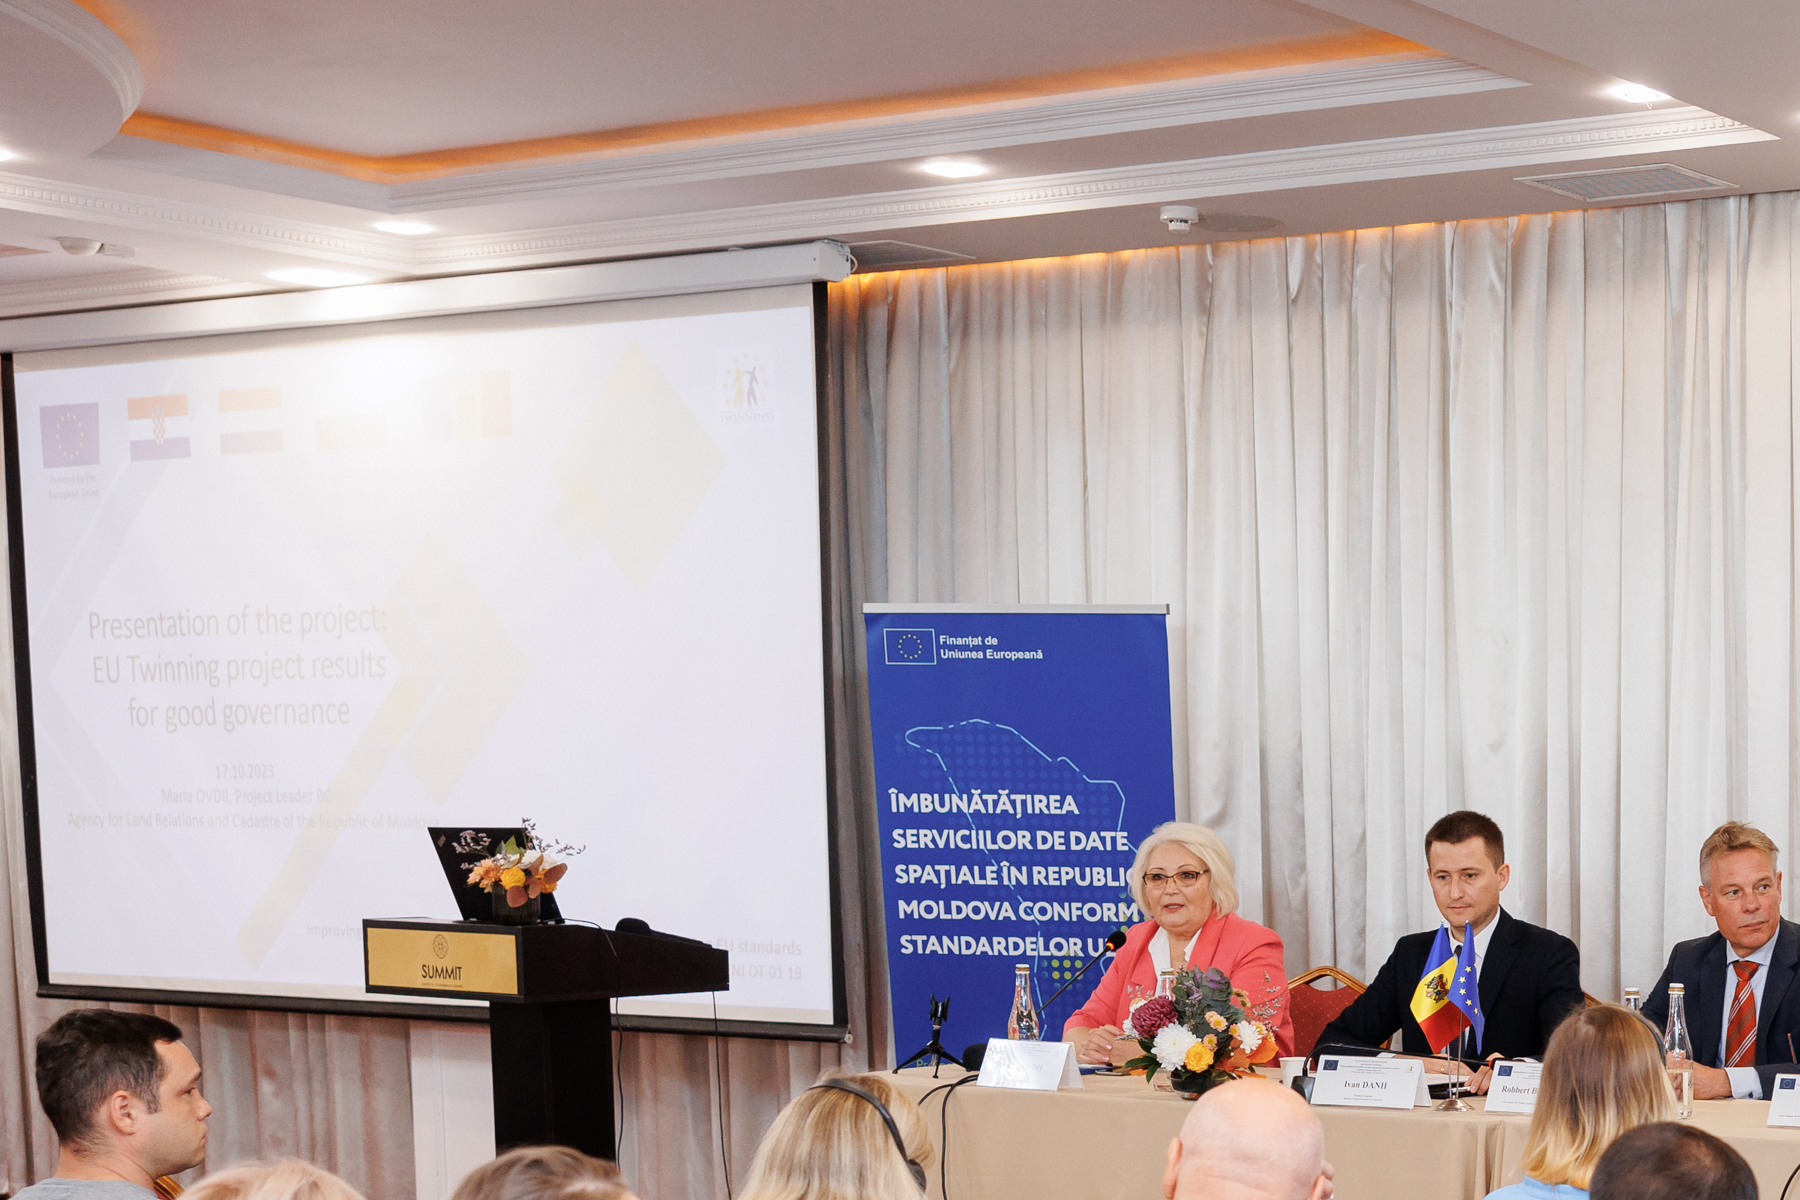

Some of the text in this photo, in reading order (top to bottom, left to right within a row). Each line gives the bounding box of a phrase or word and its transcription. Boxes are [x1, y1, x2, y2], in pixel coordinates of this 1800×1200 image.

[720, 412, 775, 423] TWINNING
[88, 604, 388, 645] Presentation of the project:
[985, 636, 998, 646] de
[940, 648, 1043, 661] Uniunea Europeană
[93, 648, 387, 688] EU Twinning project results
[128, 697, 351, 733] for good governance
[215, 763, 275, 779] 17.10.2023
[161, 788, 333, 808] Maria OVDII, Project Leader BC
[888, 788, 1080, 819] ÎMBUNĂTĂȚIREA
[68, 813, 106, 830] Agency
[108, 813, 125, 827] for
[126, 813, 152, 827] Land
[155, 813, 205, 828] Relations
[207, 813, 230, 828] and
[232, 813, 280, 829] Cadastre
[283, 813, 295, 829] of
[297, 813, 316, 829] the
[319, 813, 368, 831] Republic
[371, 814, 385, 829] of
[892, 829, 1129, 851] SERVICIILOR DE DATE
[895, 860, 1132, 889] SPAȚIALE ÎN REPUBLI
[898, 900, 1139, 922] MOLDOVA CONFORM
[306, 924, 362, 941] Improving
[738, 940, 802, 955] standards
[900, 935, 1085, 957] STANDARDELOR
[421, 964, 463, 980] SUMMIT
[748, 965, 765, 978] OT
[768, 966, 783, 979] 01
[788, 967, 802, 980] 19
[1344, 1080, 1360, 1088] Ivan
[1501, 1085, 1530, 1094] Robbert
